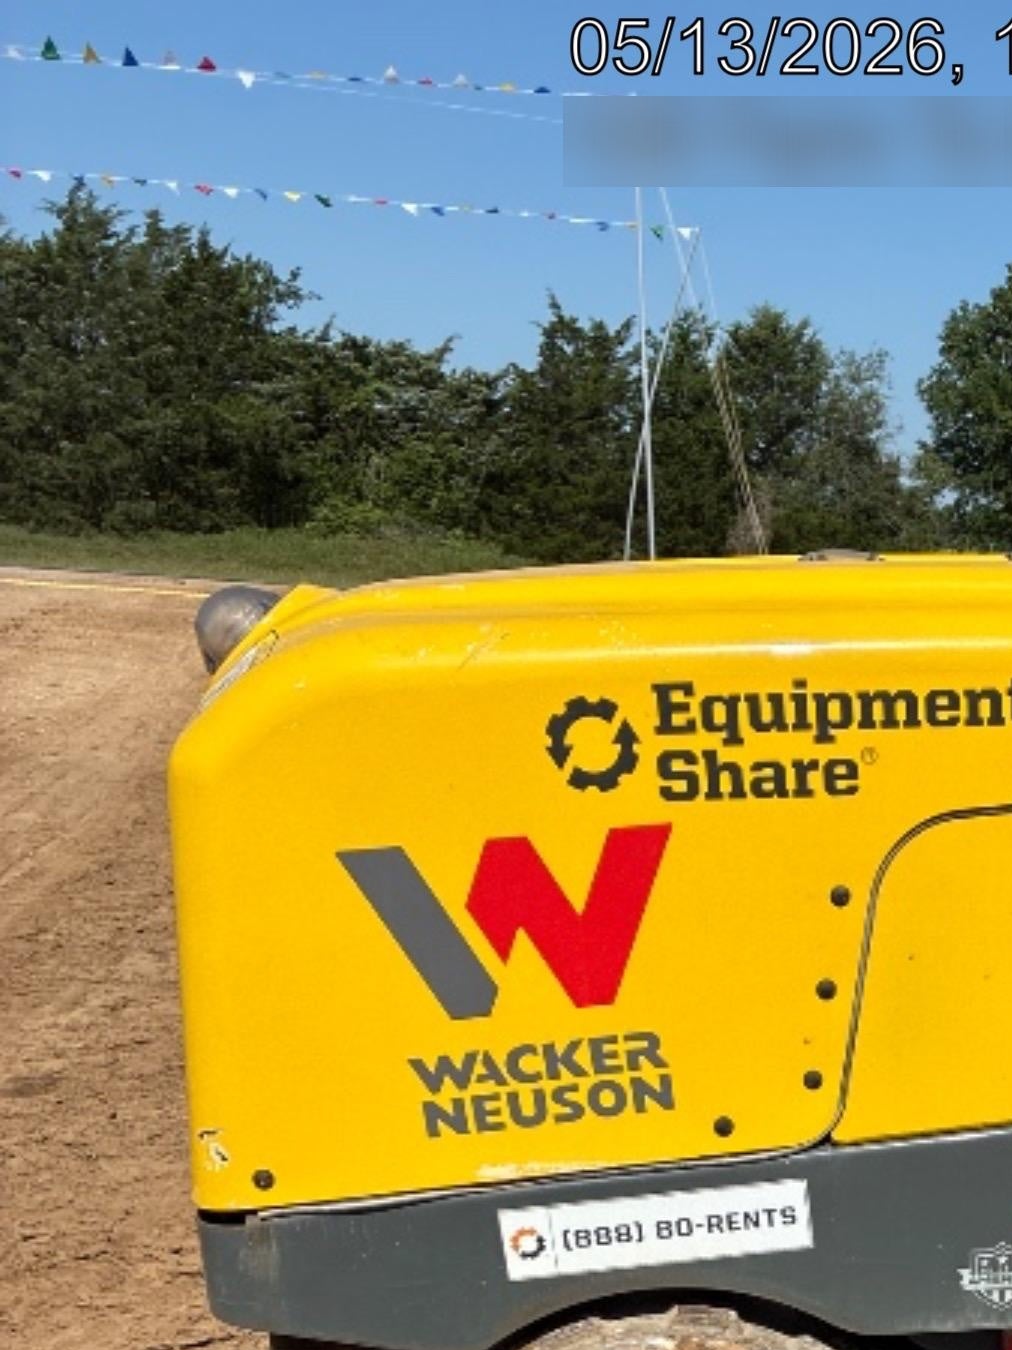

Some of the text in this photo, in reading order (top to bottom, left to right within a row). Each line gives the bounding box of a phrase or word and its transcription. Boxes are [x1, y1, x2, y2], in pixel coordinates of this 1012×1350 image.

[406, 1031, 671, 1096] WACKER
[421, 1073, 676, 1139] NEUSON
[562, 1205, 797, 1252] (888) 80-RENTS
